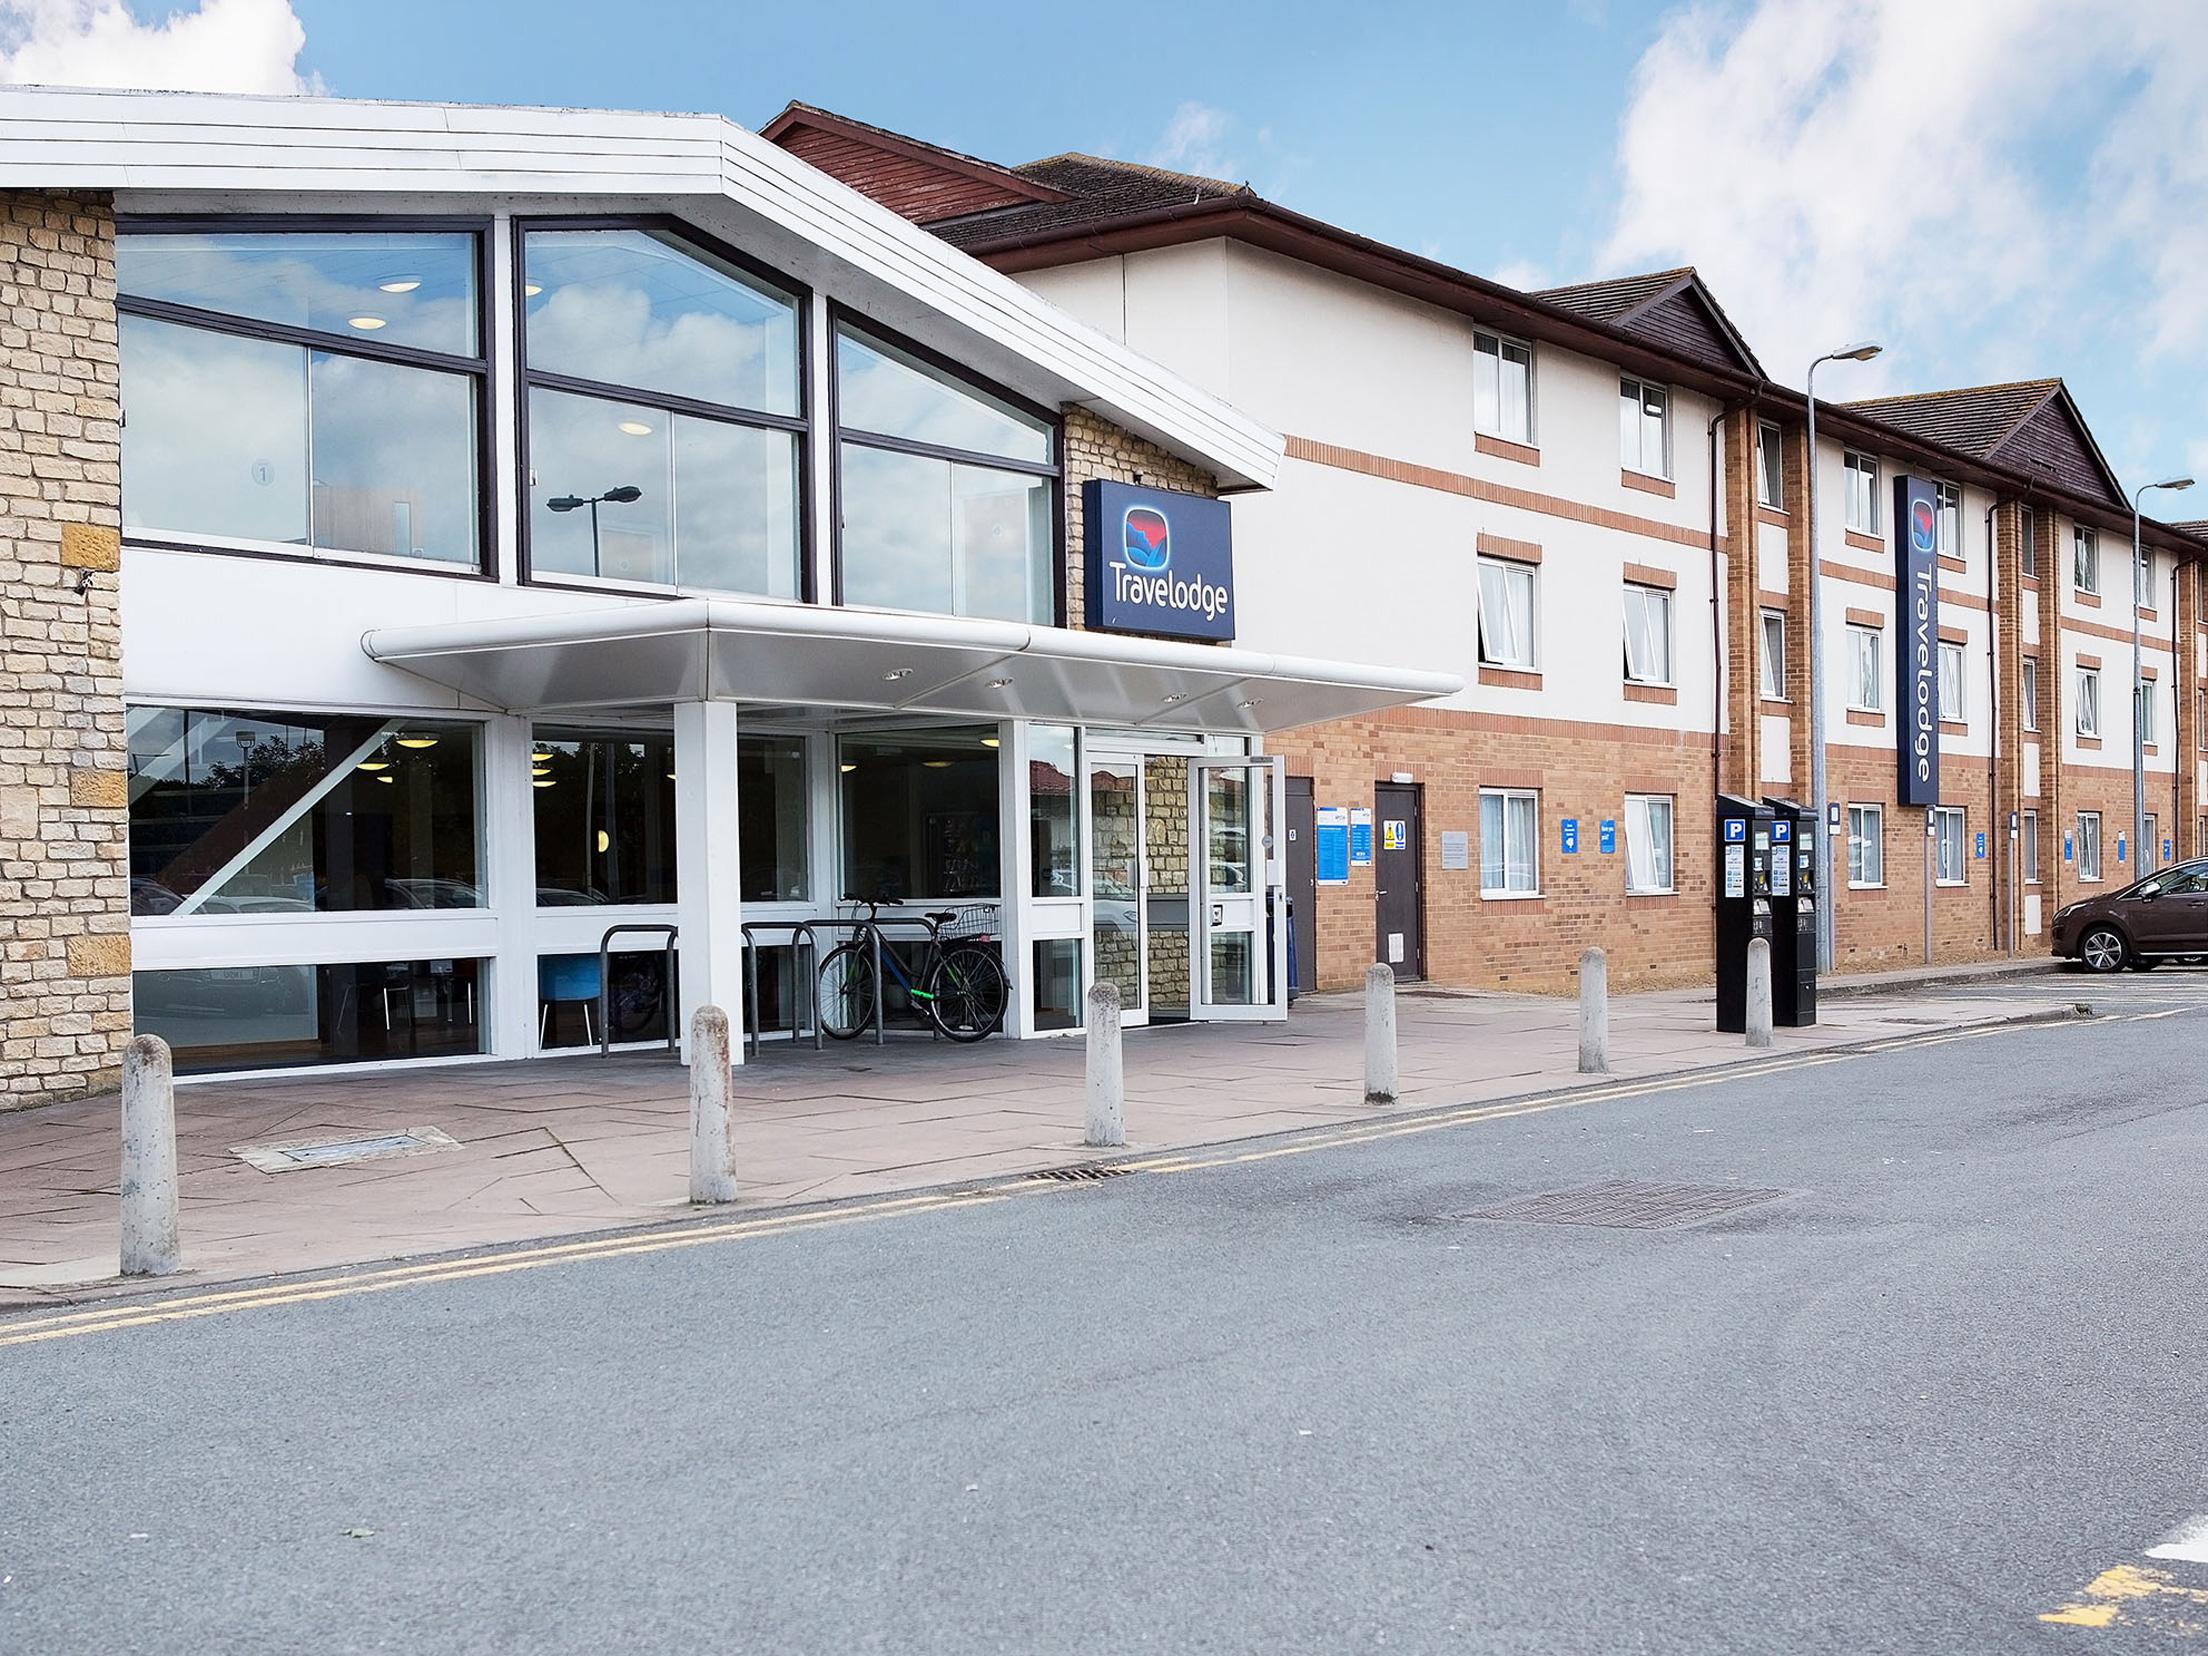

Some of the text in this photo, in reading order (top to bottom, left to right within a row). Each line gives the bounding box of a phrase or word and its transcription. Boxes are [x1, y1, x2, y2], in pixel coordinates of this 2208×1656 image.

[1109, 561, 1228, 621] Travelodge
[1915, 564, 1932, 783] Travelodge
[1730, 823, 1742, 838] P
[1776, 824, 1787, 838] P
